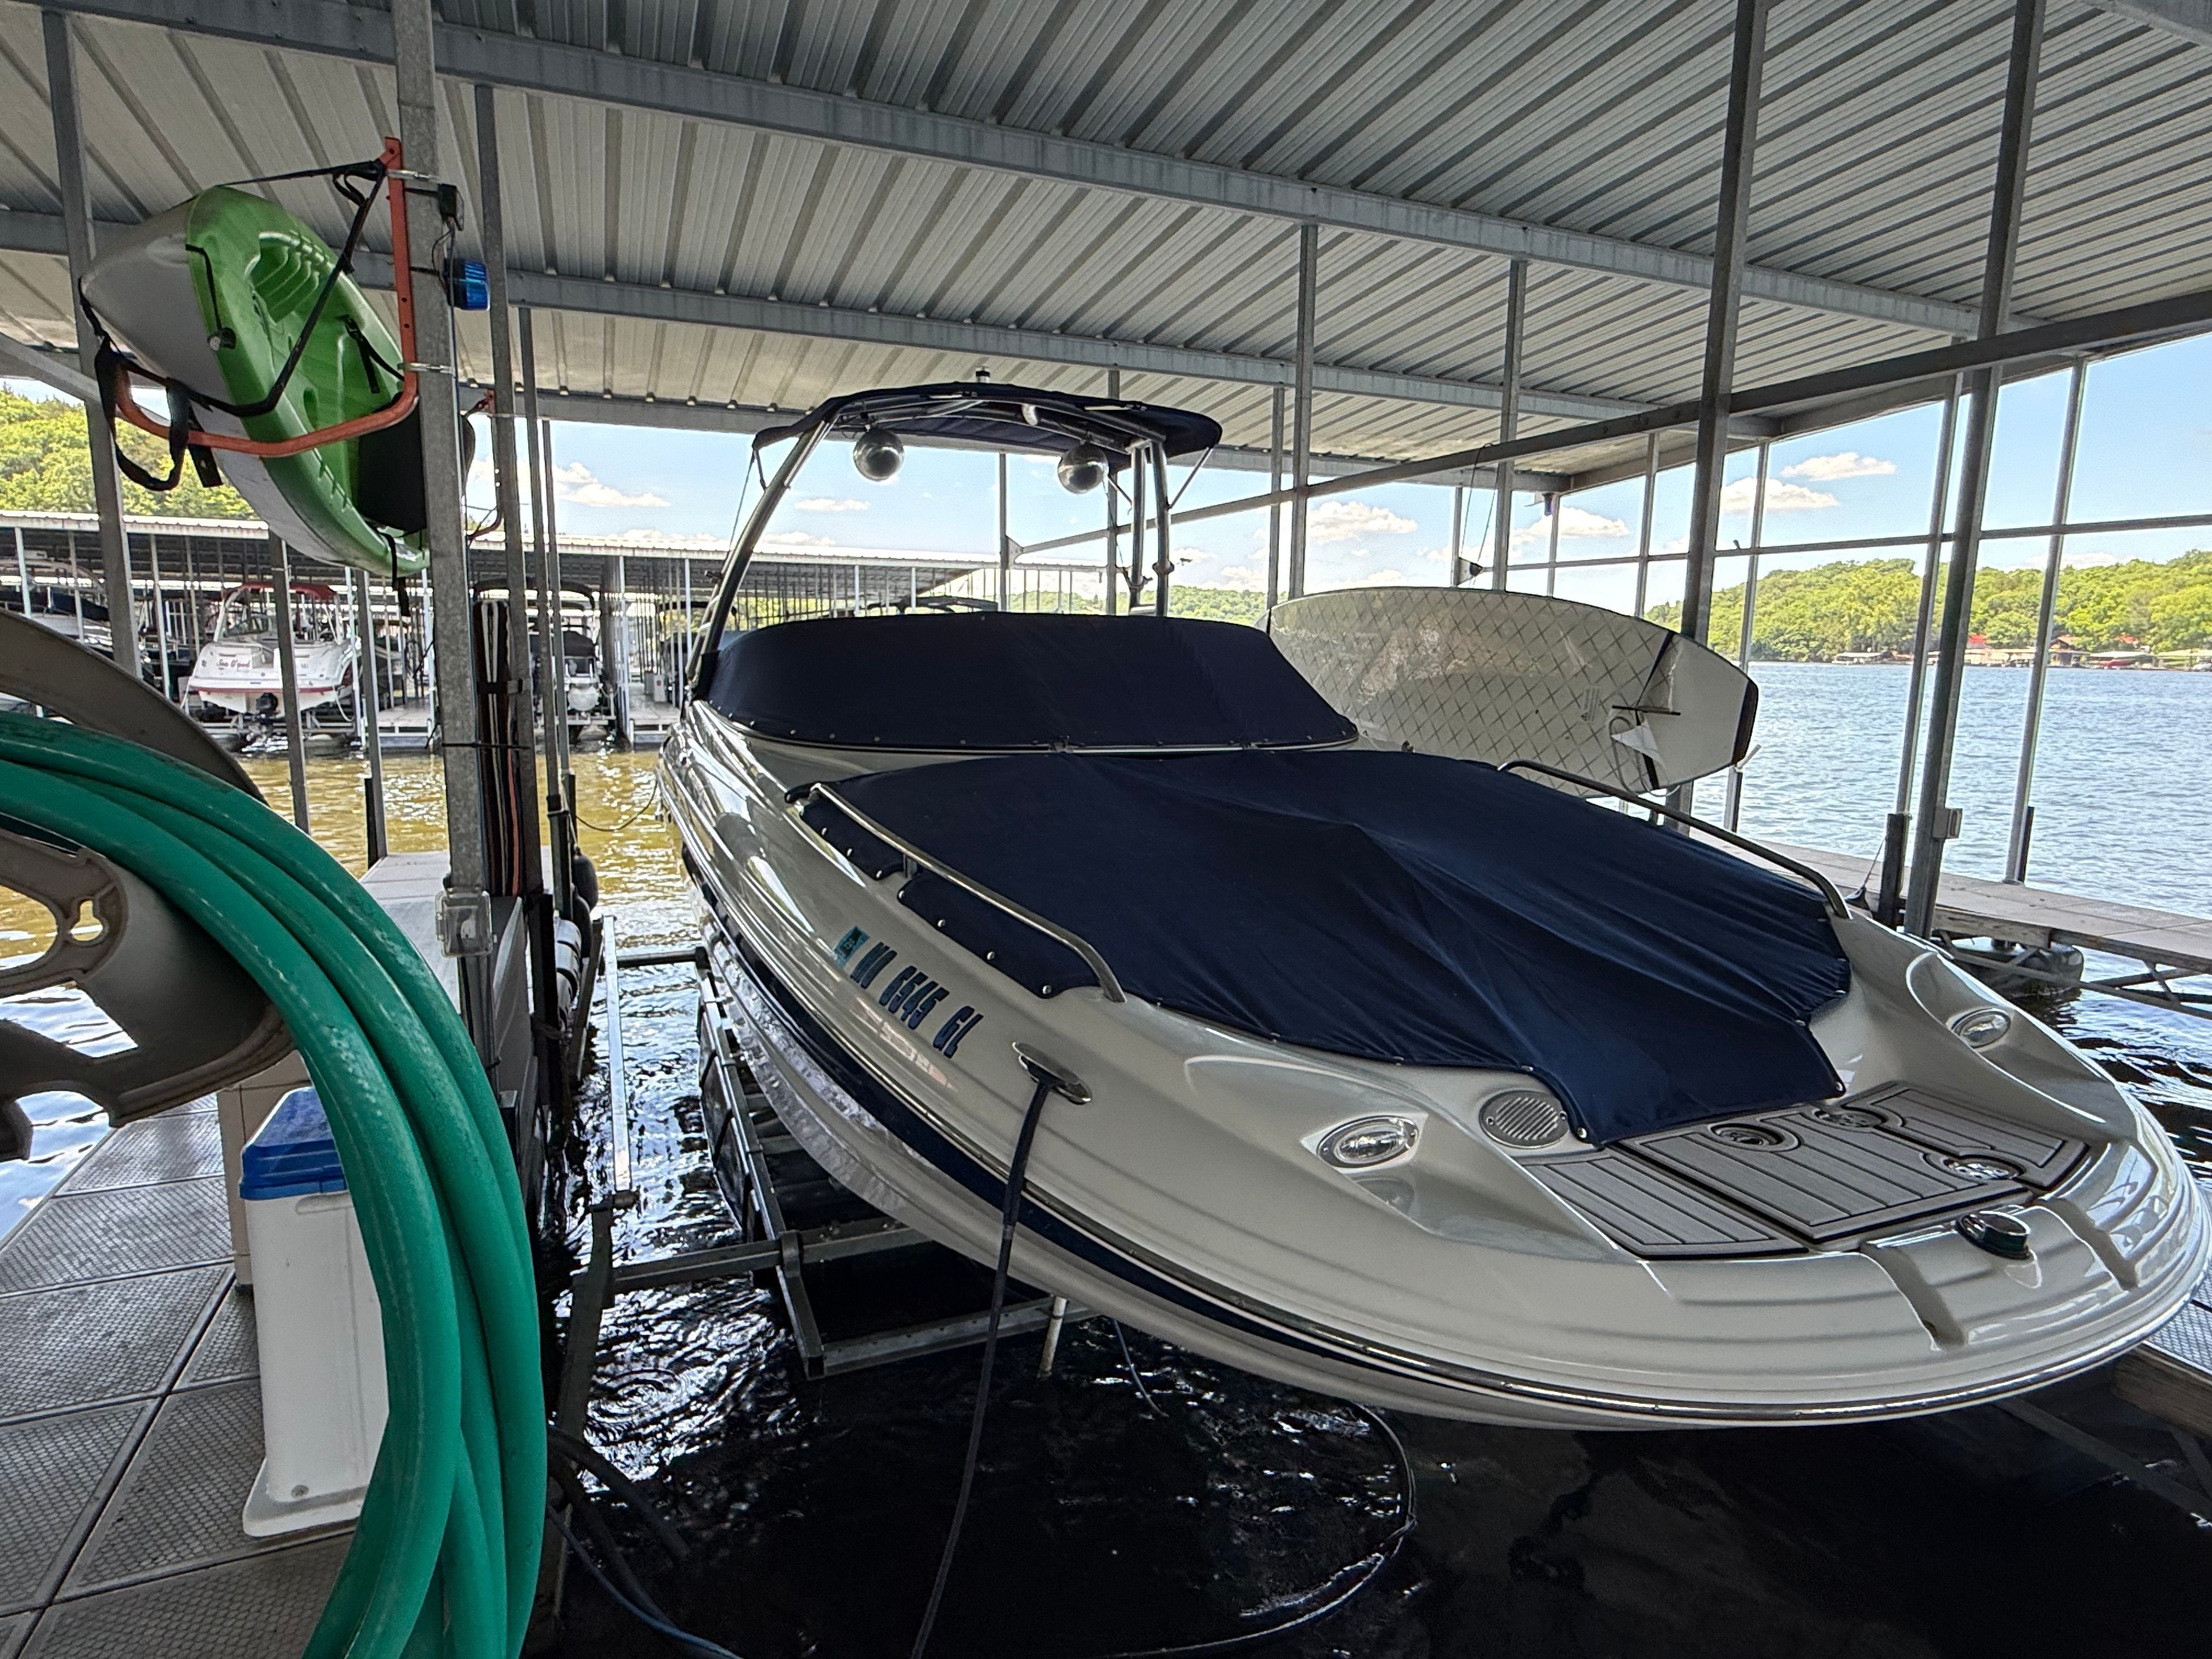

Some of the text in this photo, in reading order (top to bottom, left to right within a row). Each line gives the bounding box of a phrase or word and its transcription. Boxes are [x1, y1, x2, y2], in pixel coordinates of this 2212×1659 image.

[850, 941, 984, 1059] MO 6545 GL
